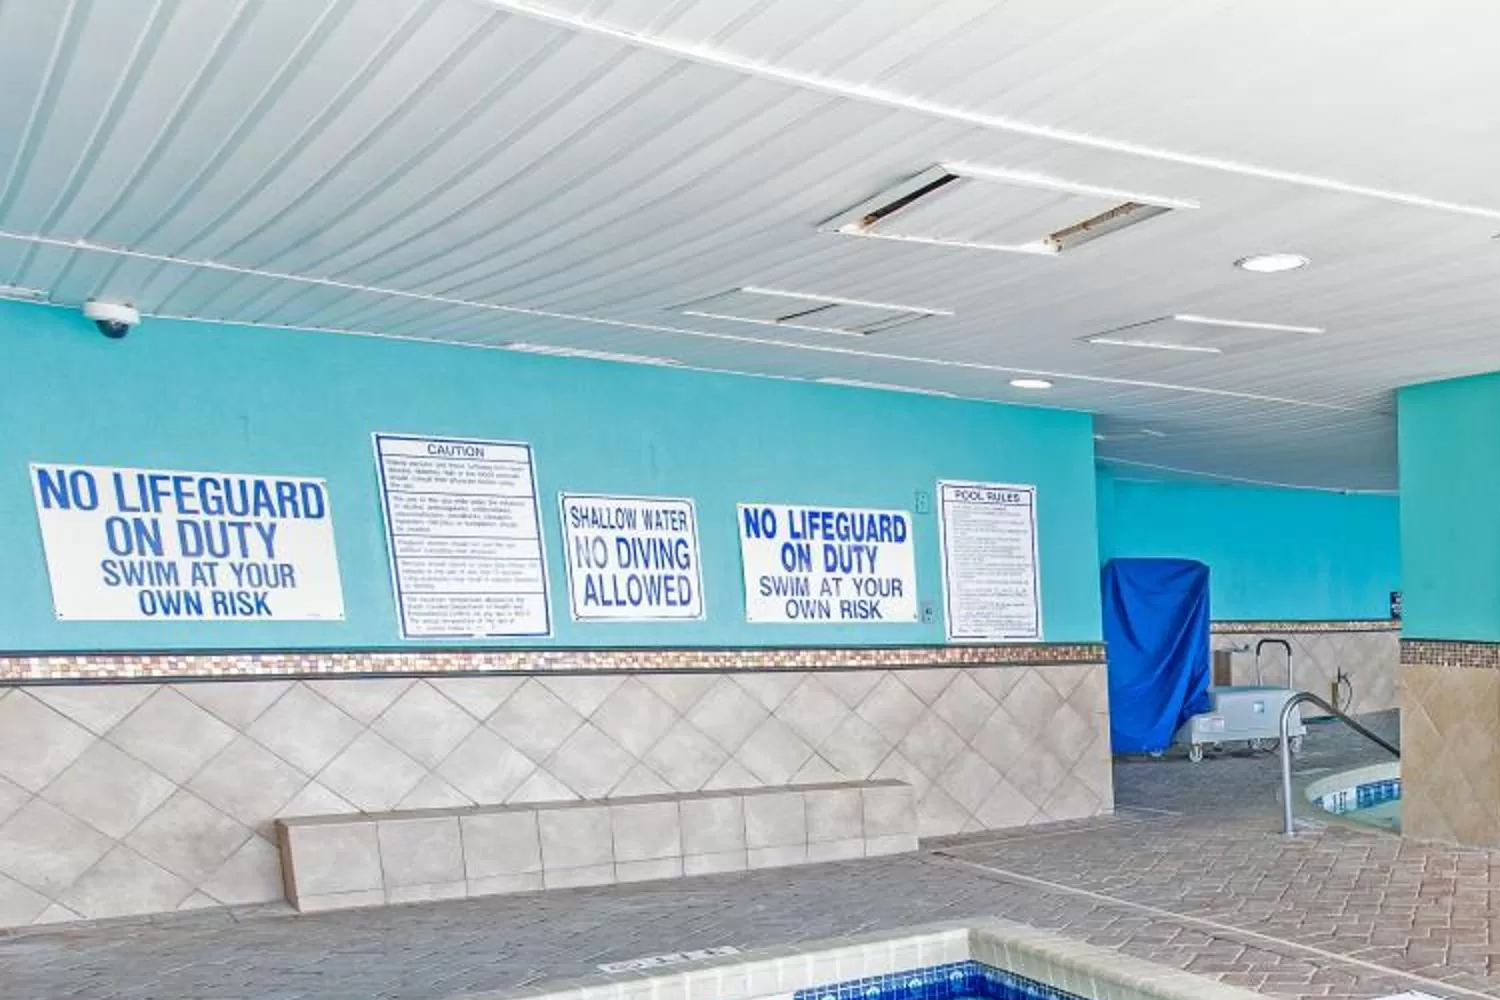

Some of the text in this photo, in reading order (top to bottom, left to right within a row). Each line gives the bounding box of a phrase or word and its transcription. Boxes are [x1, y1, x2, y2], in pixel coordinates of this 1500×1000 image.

[427, 443, 485, 458] CAUTION
[37, 469, 326, 520] NO LIFEGUARD
[954, 489, 1021, 503] POOL RULES
[569, 505, 688, 533] SHALLOW WATER
[743, 507, 907, 544] NO LIFEGUARD
[105, 516, 278, 560] ON DUTY
[575, 535, 691, 571] NO DIVING
[781, 542, 878, 575] ON DUTY
[101, 559, 297, 590] SWIM AT YOUR
[759, 575, 904, 598] SWIM AT YOUR
[139, 589, 273, 617] OWN RISK
[584, 573, 693, 608] ALLOWED
[785, 599, 884, 620] OWN RISK
